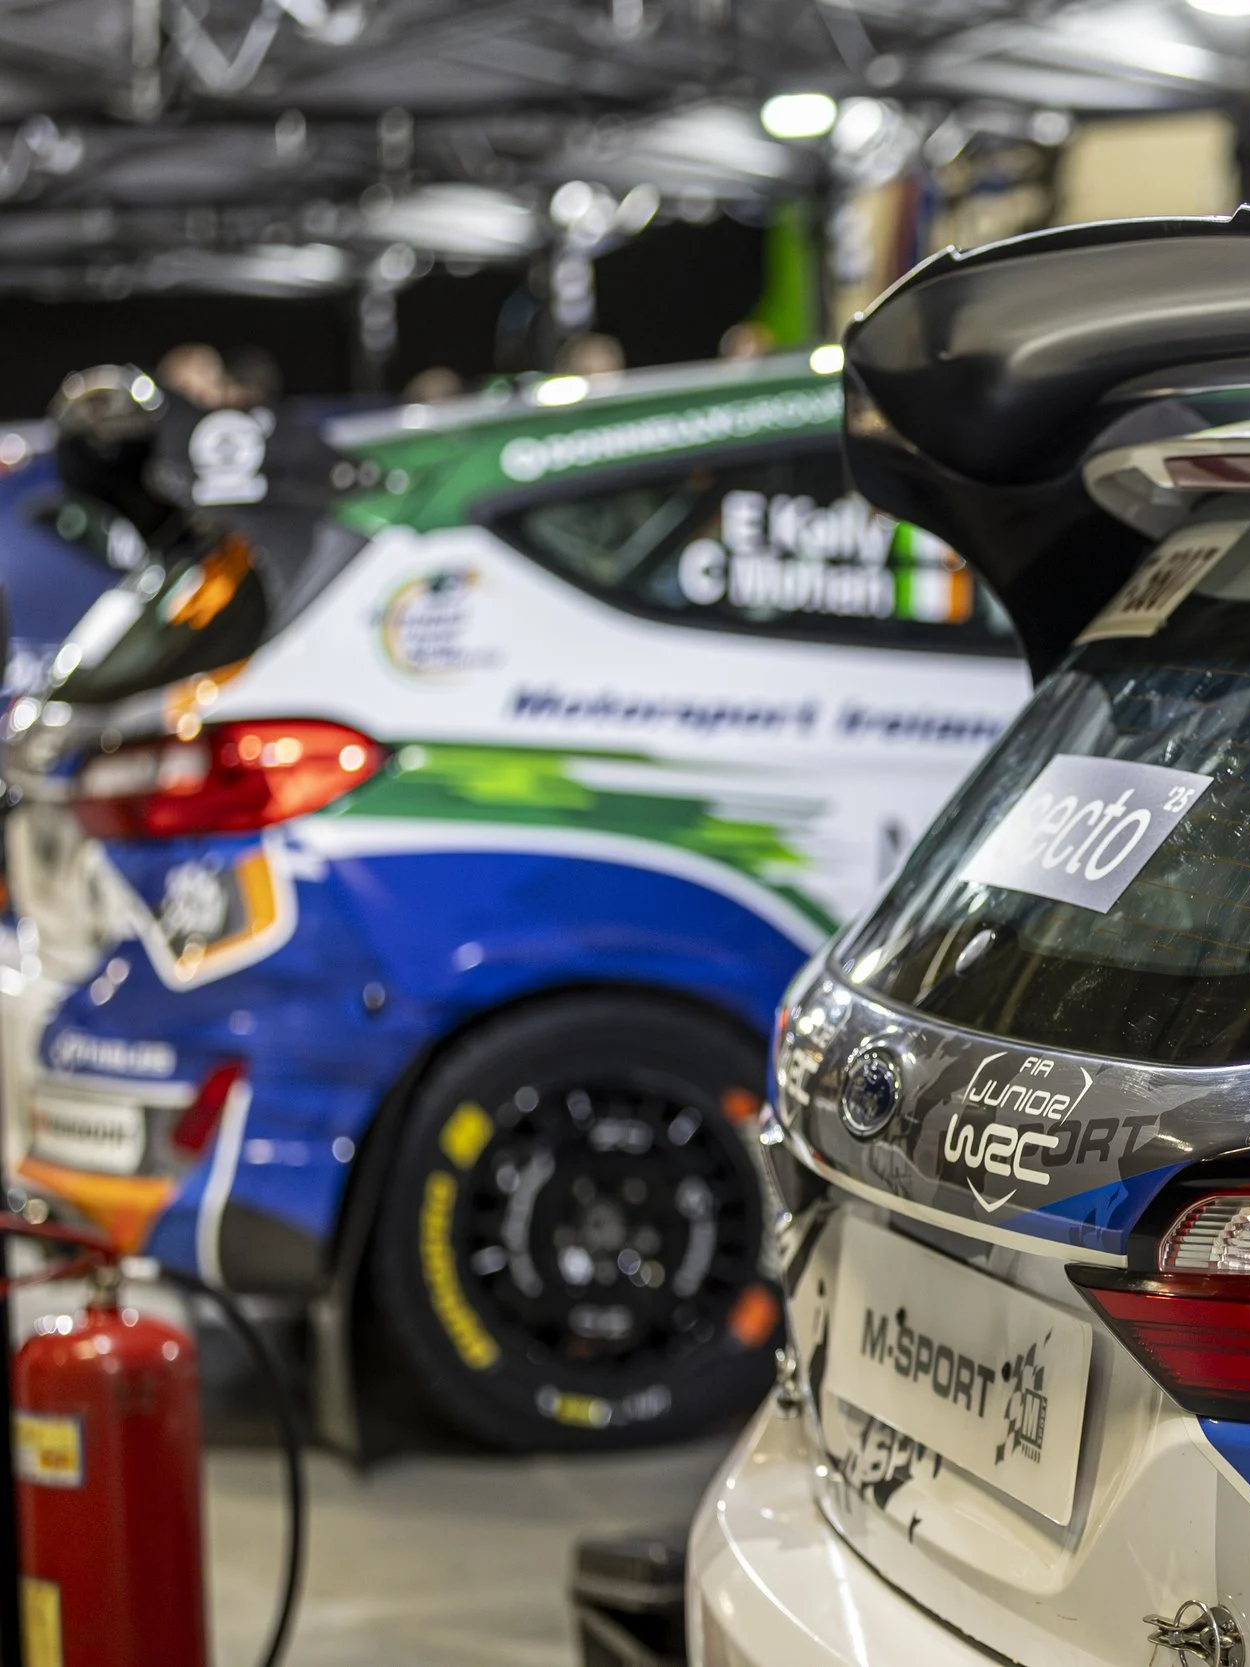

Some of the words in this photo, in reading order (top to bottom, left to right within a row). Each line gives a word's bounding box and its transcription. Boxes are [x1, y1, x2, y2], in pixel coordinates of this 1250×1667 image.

[721, 490, 768, 552] E
[678, 538, 728, 605] C
[1020, 1056, 1055, 1078] FIA
[969, 1079, 1071, 1120] JUNIOR
[861, 1307, 995, 1418] M-SPORT
